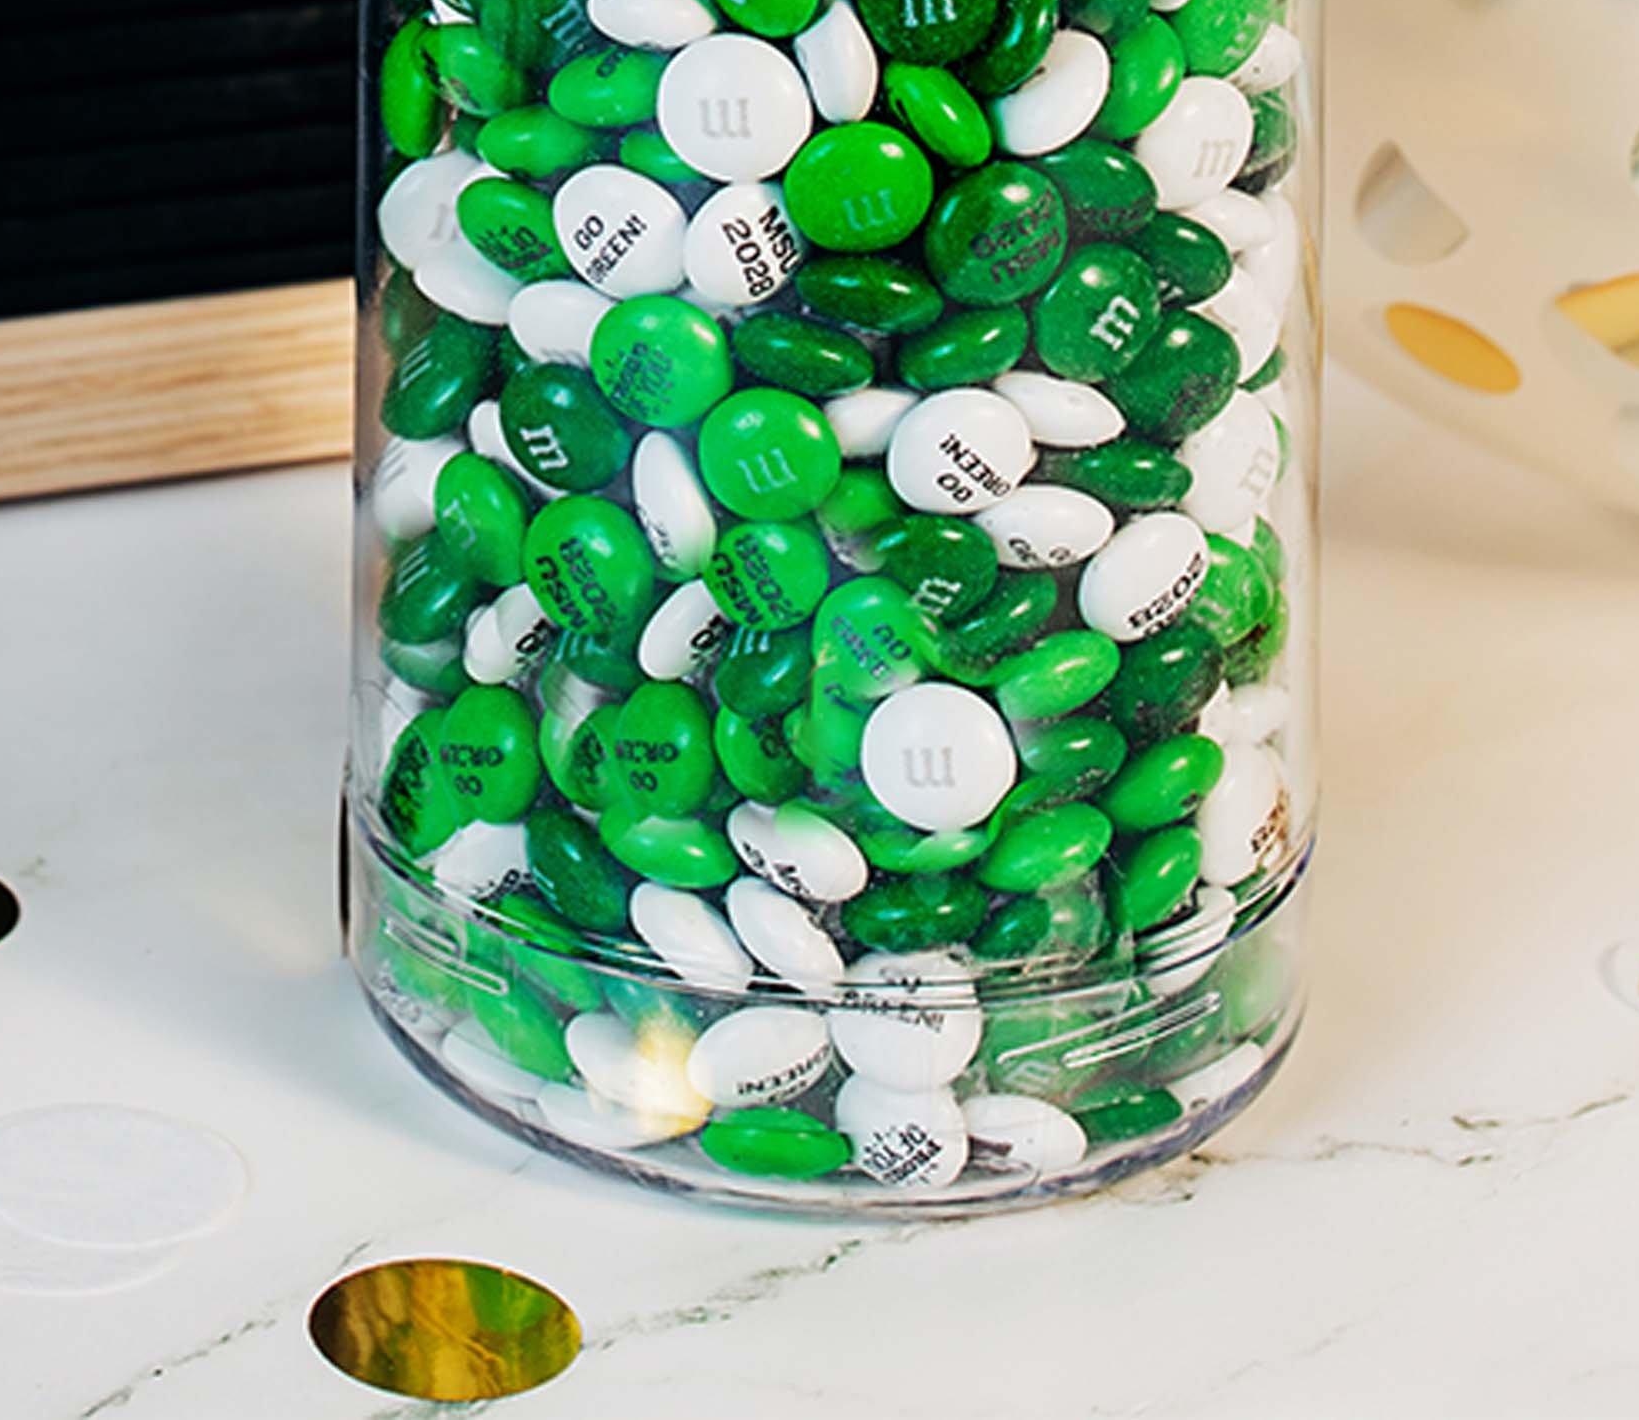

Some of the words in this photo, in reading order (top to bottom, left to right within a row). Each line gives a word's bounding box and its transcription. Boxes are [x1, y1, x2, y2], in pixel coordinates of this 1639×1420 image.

[699, 98, 752, 139] m
[575, 214, 604, 251] GO
[843, 189, 897, 231] m
[586, 214, 648, 284] GREEN!
[722, 218, 775, 298] 2028
[759, 205, 802, 275] MSU
[1090, 295, 1140, 352] m
[520, 425, 569, 470] m
[939, 433, 1011, 497] GREEN!
[737, 447, 797, 494] m
[937, 473, 973, 503] GO
[910, 576, 962, 616] m
[903, 746, 956, 788] m
